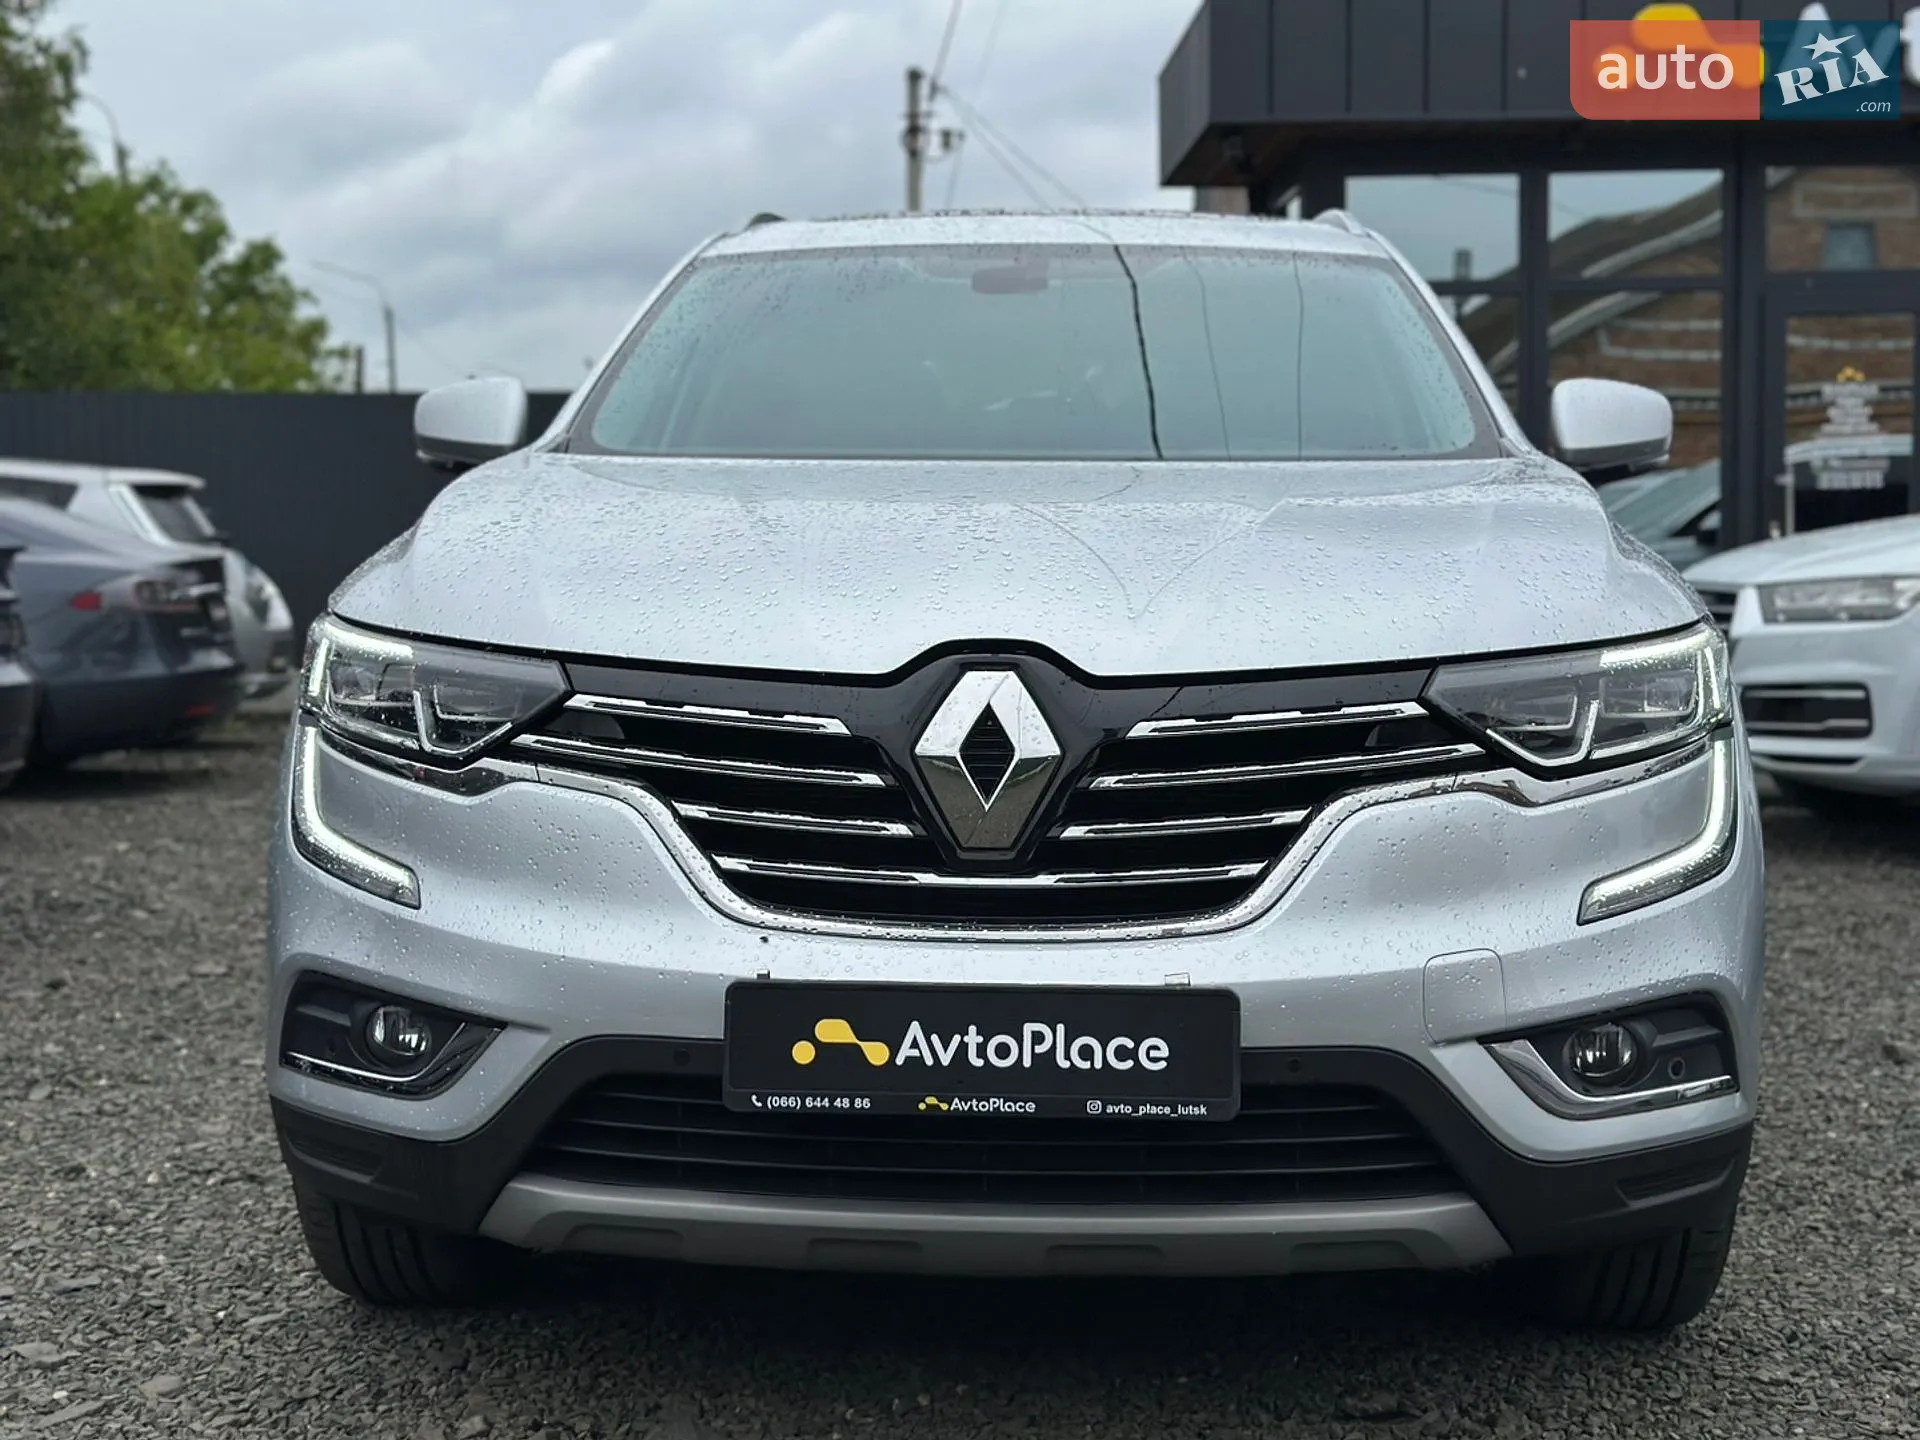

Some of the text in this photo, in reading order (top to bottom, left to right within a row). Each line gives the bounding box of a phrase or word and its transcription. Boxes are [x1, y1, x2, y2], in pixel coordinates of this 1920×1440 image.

[895, 1020, 1170, 1071] AvtoPlace
[766, 1095, 871, 1110] (066) 644 48 86
[950, 1097, 1036, 1113] AvtoPlace
[1105, 1103, 1207, 1117] avto_place_lutsk
